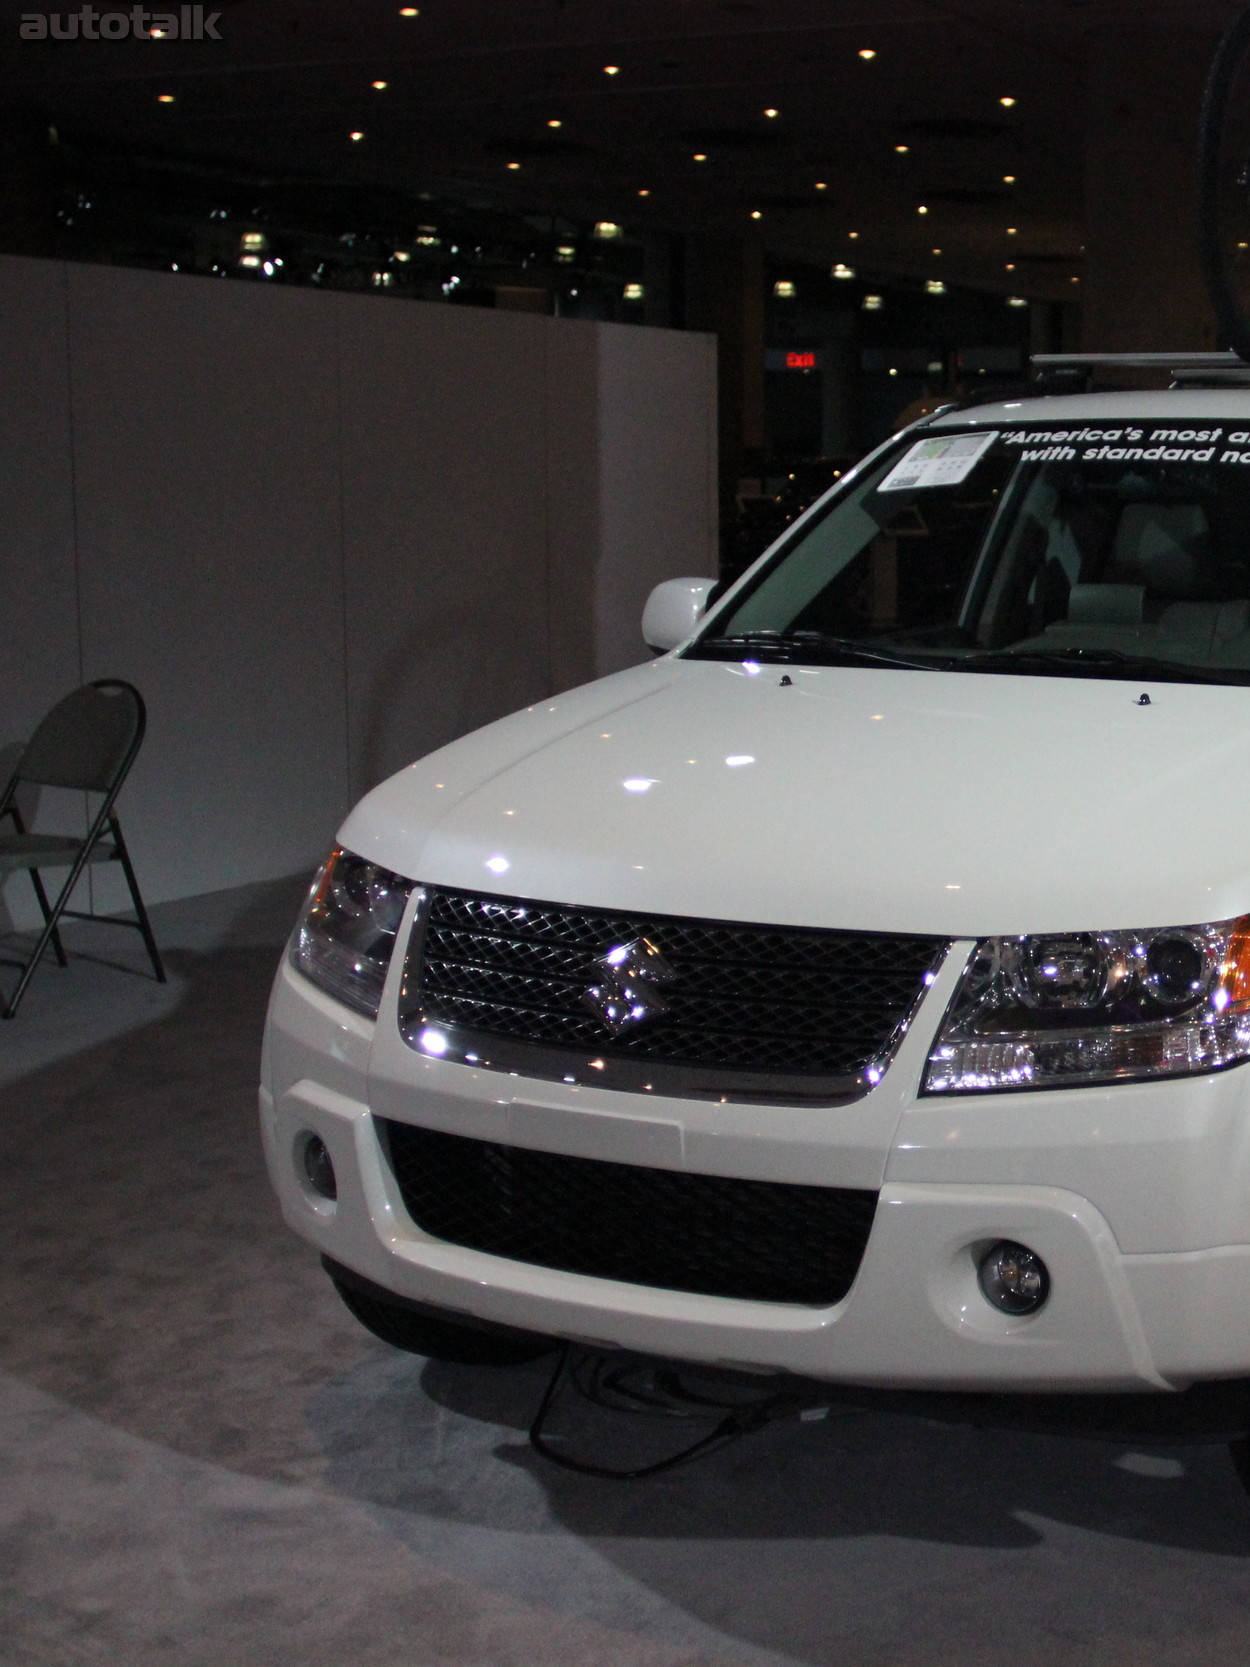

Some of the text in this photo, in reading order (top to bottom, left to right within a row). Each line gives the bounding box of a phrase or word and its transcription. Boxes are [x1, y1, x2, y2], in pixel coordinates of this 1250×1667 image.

[1149, 428, 1223, 443] most
[1020, 446, 1077, 461] with
[1082, 446, 1217, 462] standard
